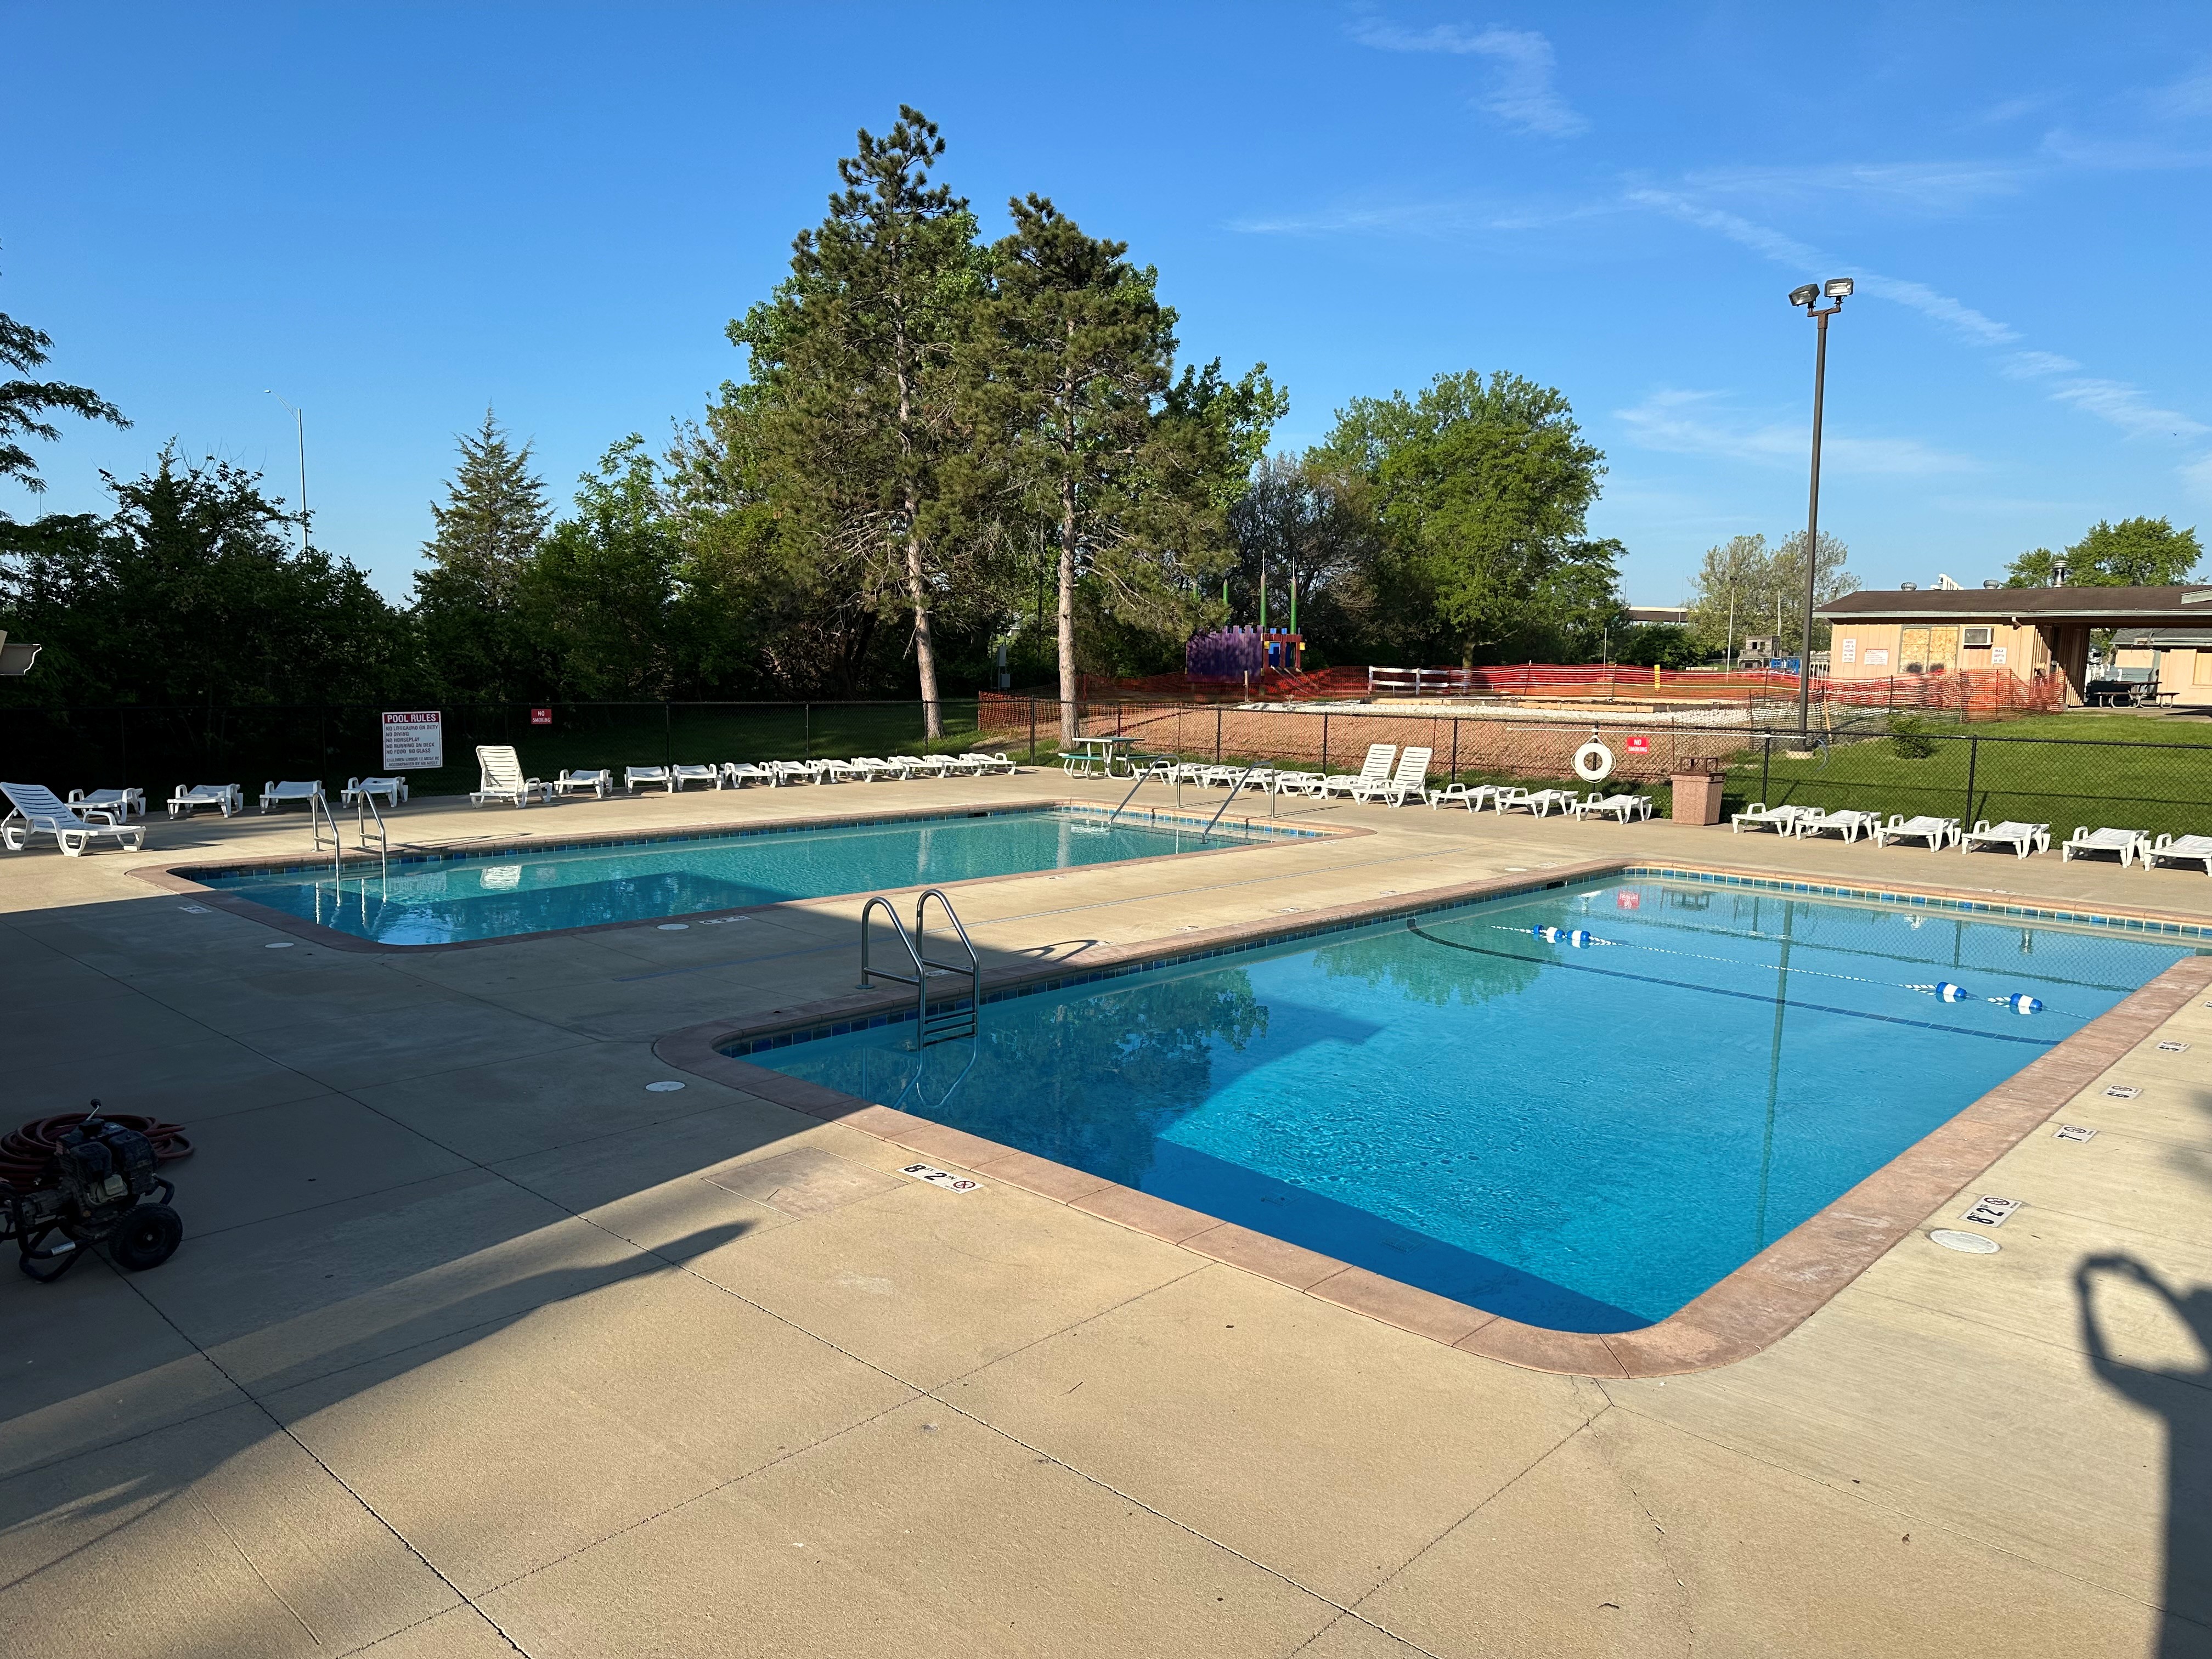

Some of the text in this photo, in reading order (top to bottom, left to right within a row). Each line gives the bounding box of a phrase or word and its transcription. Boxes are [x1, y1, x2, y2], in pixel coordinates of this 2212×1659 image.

[387, 714, 436, 723] POOL RULES
[923, 1172, 947, 1181] 2
[1976, 1207, 2005, 1217] 2
[1967, 1216, 1994, 1224] 8
